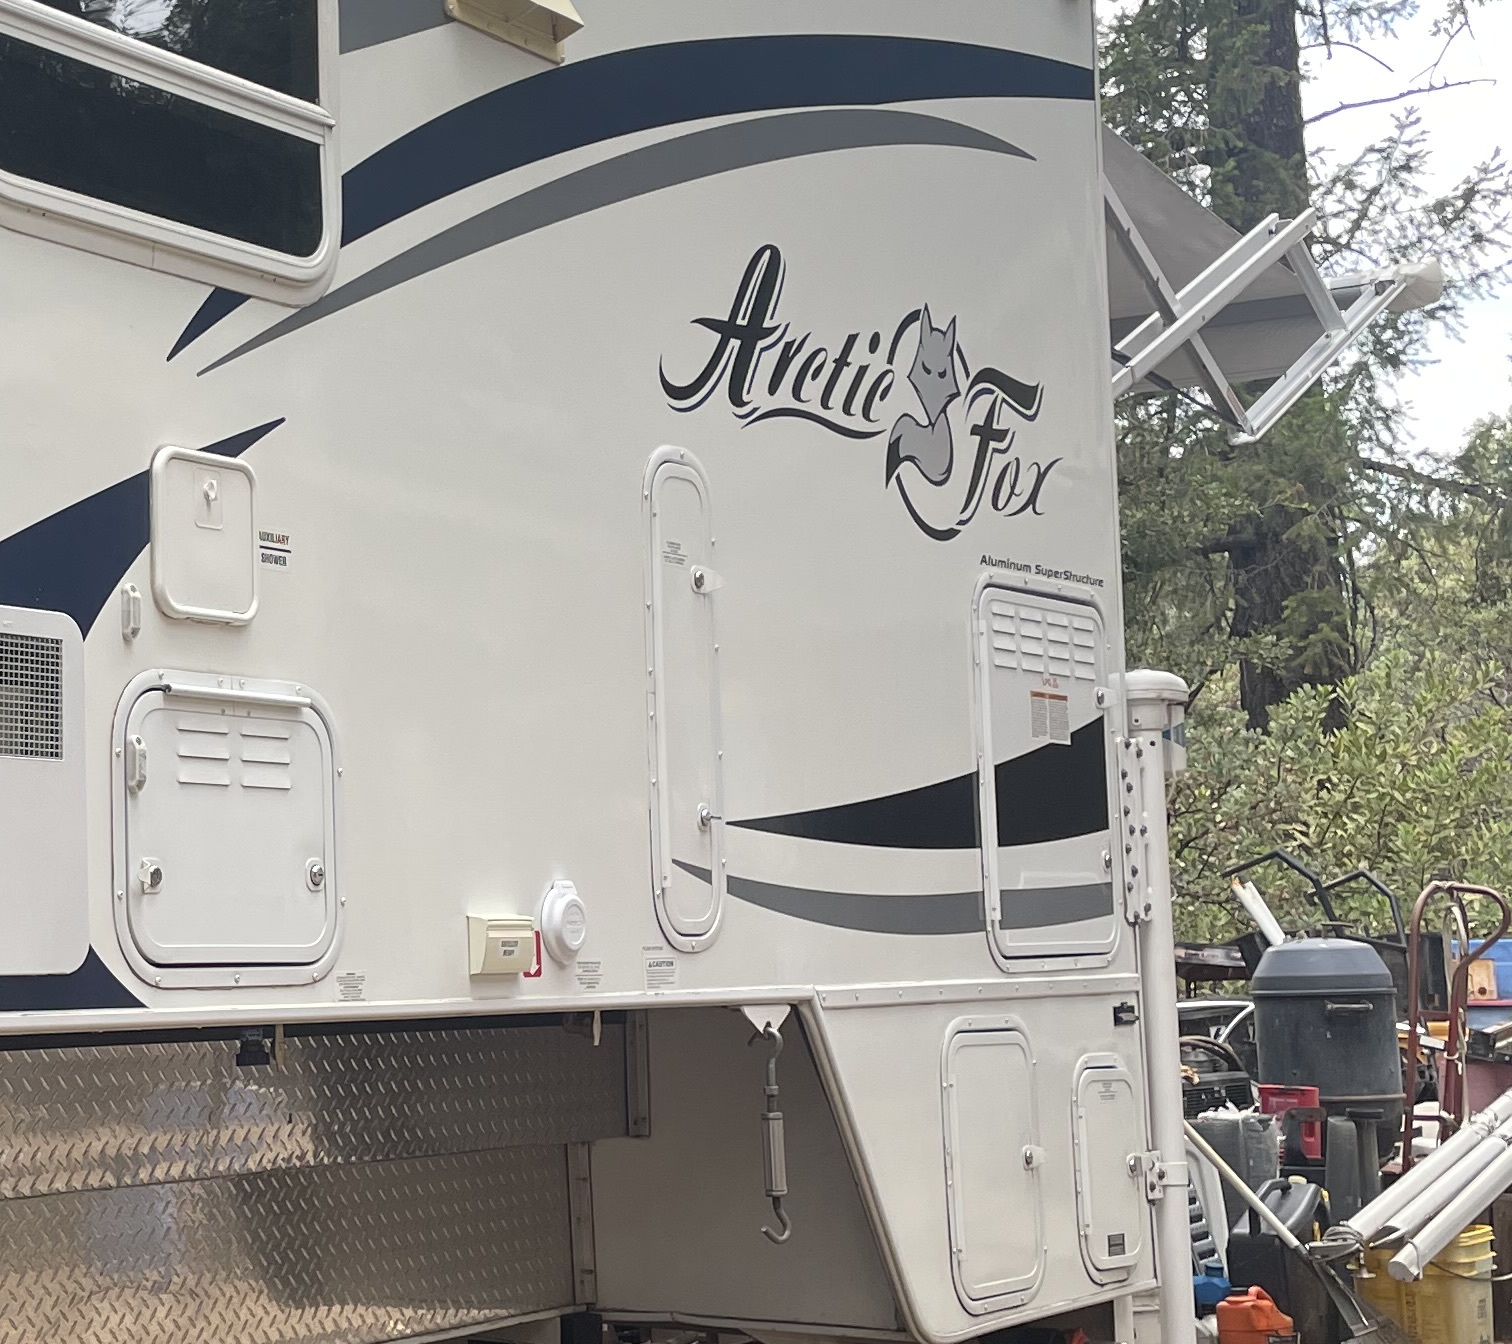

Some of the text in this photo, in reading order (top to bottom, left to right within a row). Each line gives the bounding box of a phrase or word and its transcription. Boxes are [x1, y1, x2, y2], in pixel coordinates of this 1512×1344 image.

[659, 244, 896, 424] Arctic
[956, 367, 1064, 526] Fox
[261, 552, 287, 566] SHOWER
[980, 554, 1104, 588] Aluminum SuperStructure
